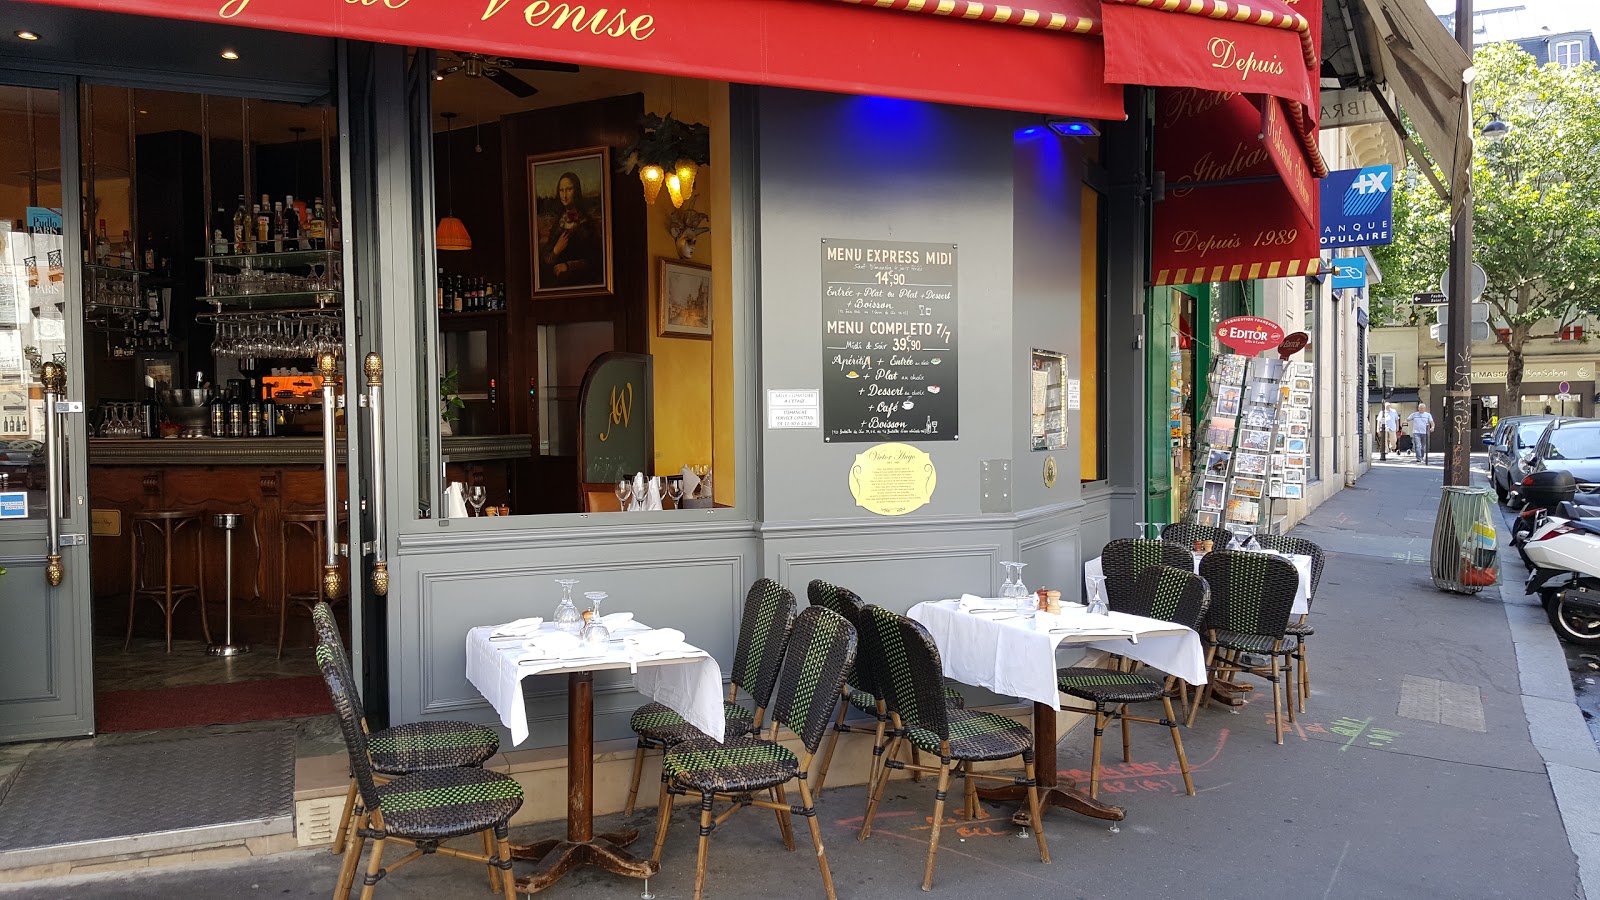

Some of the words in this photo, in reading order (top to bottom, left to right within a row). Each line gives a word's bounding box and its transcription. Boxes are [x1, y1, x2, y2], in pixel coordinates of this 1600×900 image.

[1207, 36, 1284, 81] Depuis
[33, 215, 58, 228] Pudlo
[1324, 220, 1388, 234] ANQUE
[33, 225, 58, 235] PARIS
[1172, 229, 1242, 258] Depuis
[1253, 228, 1298, 247] 1989
[1320, 231, 1388, 245] OPULAIRE
[827, 247, 862, 262] MENU
[866, 248, 920, 264] EXPRESS
[925, 251, 952, 265] MIDI
[35, 284, 59, 295] PARIS
[826, 286, 854, 298] Entrée
[863, 287, 884, 298] Plat
[898, 288, 918, 299] Plat
[854, 298, 894, 310] Boisson
[827, 321, 864, 334] MENU
[869, 321, 933, 336] COMPLETO
[936, 323, 952, 344] 7/7
[845, 341, 863, 350] Midi
[889, 354, 914, 366] Entrée
[874, 368, 899, 381] Plat
[867, 384, 904, 397] Dessert
[876, 401, 900, 418] Café
[868, 416, 908, 429] Boisson
[868, 450, 893, 461] Victor
[893, 449, 916, 464] Hugo
